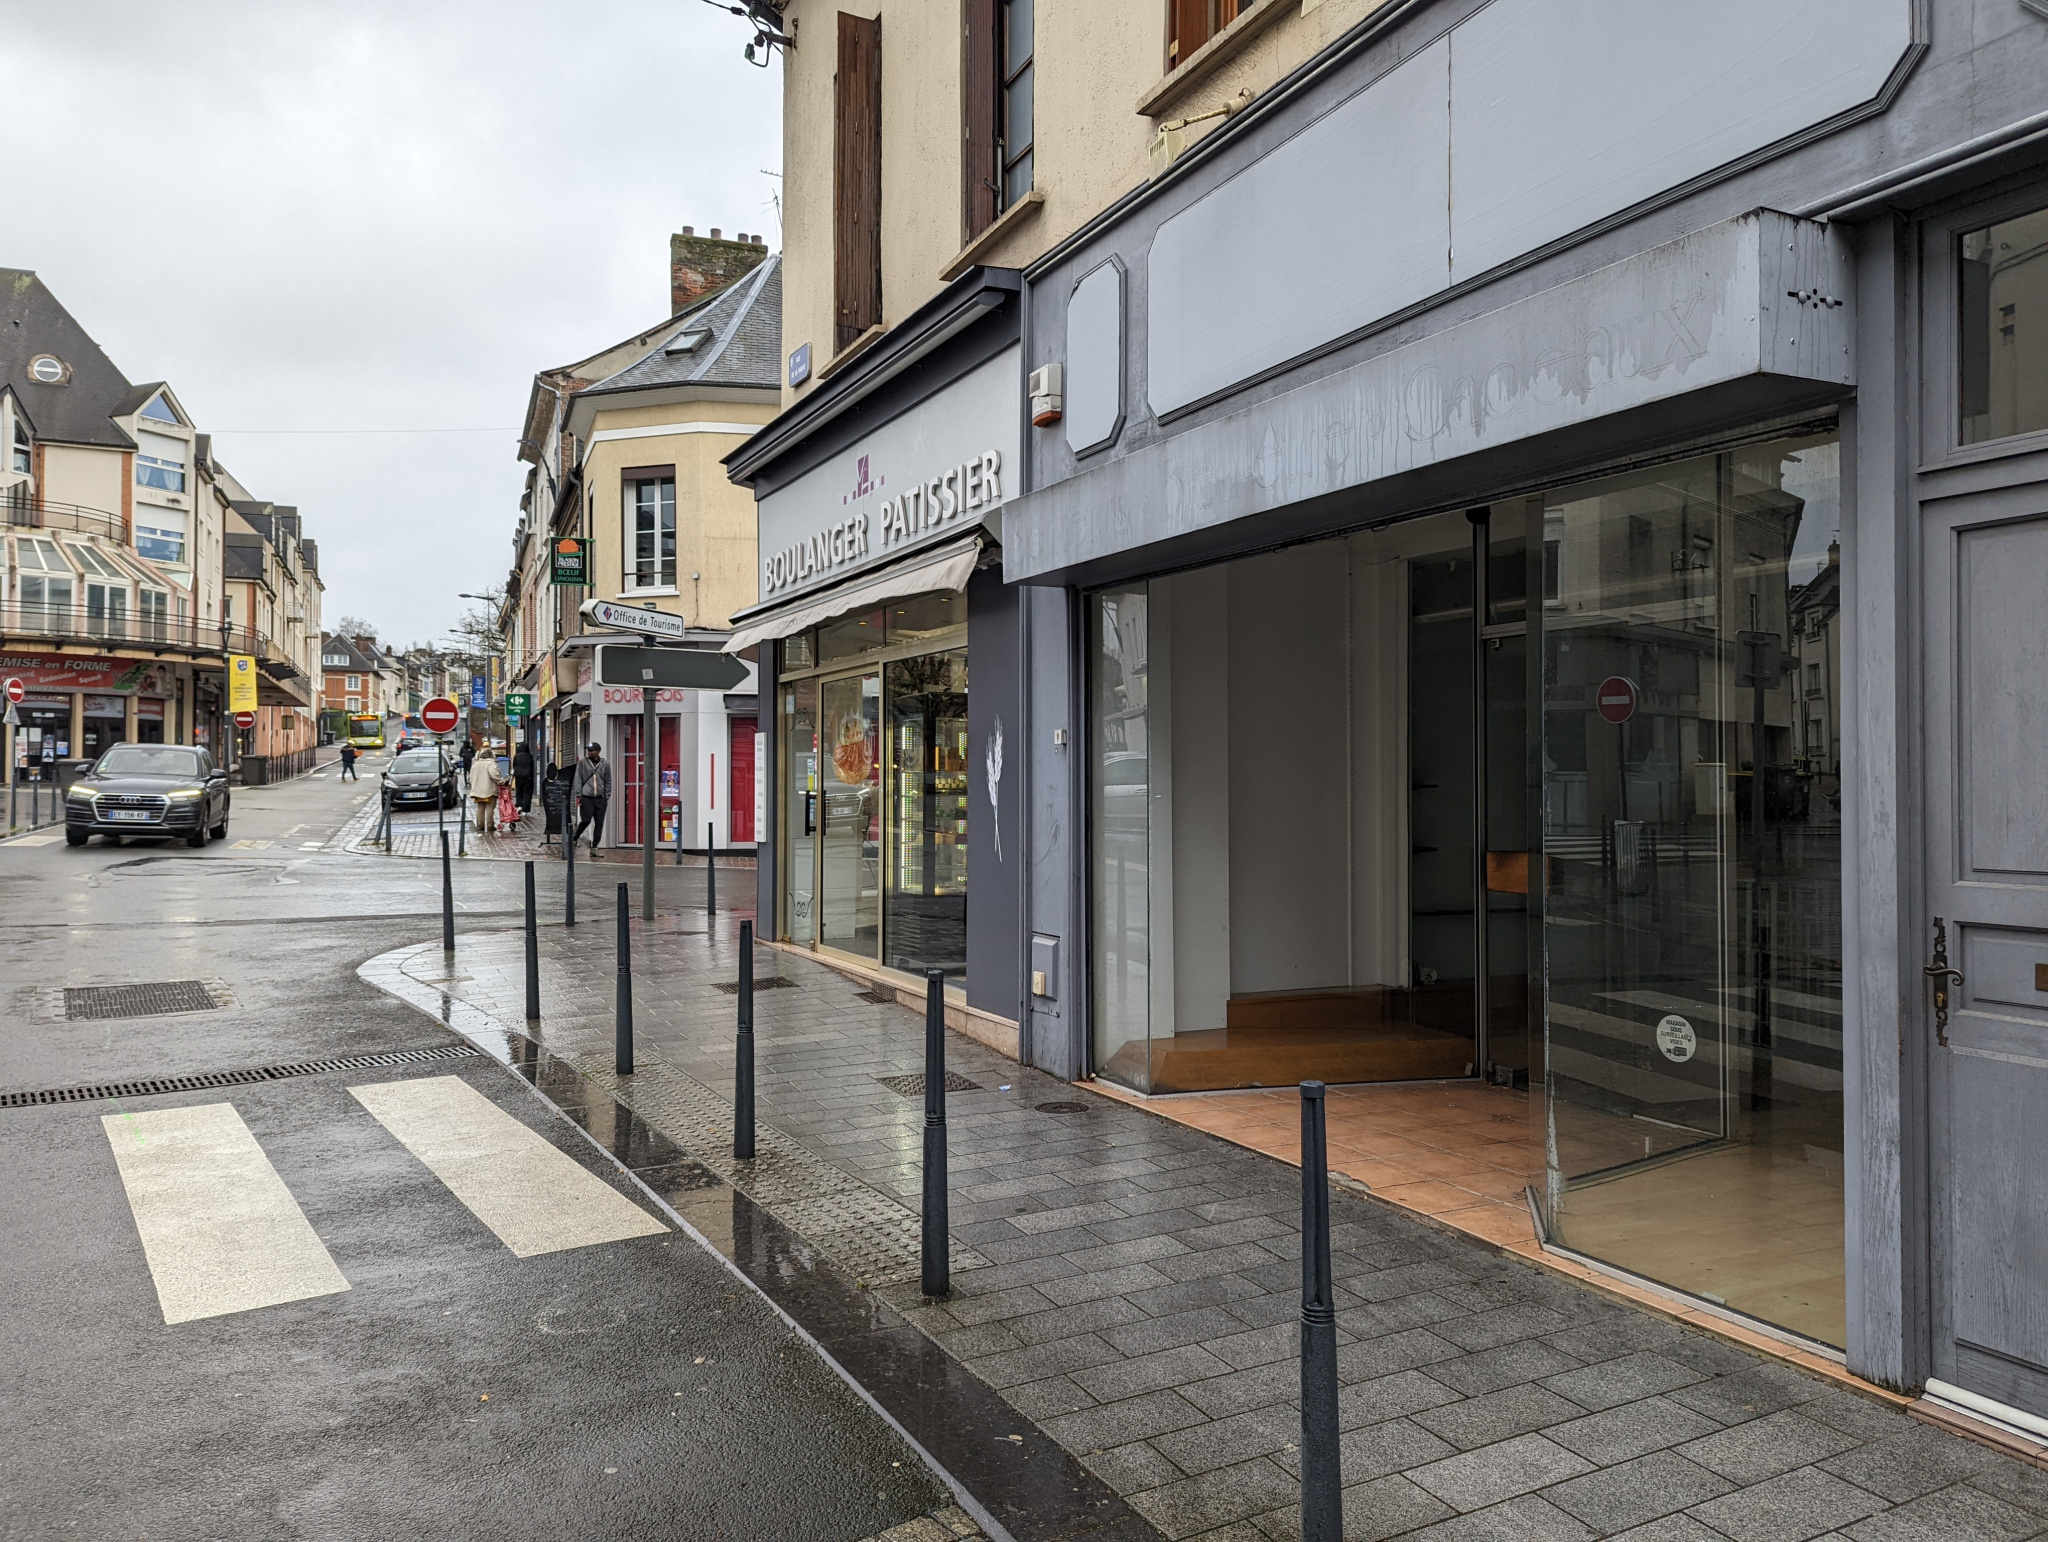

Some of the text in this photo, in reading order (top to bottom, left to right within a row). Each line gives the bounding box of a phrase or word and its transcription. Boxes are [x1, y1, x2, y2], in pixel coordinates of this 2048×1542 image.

[764, 512, 869, 592] BOULANGER
[880, 449, 1001, 545] PATISSIER
[613, 609, 681, 632] Office de Tourisme
[63, 660, 112, 671] FORME
[39, 671, 76, 683] Badminton
[78, 674, 102, 684] Squash
[1666, 1019, 1687, 1027] MAGASIN
